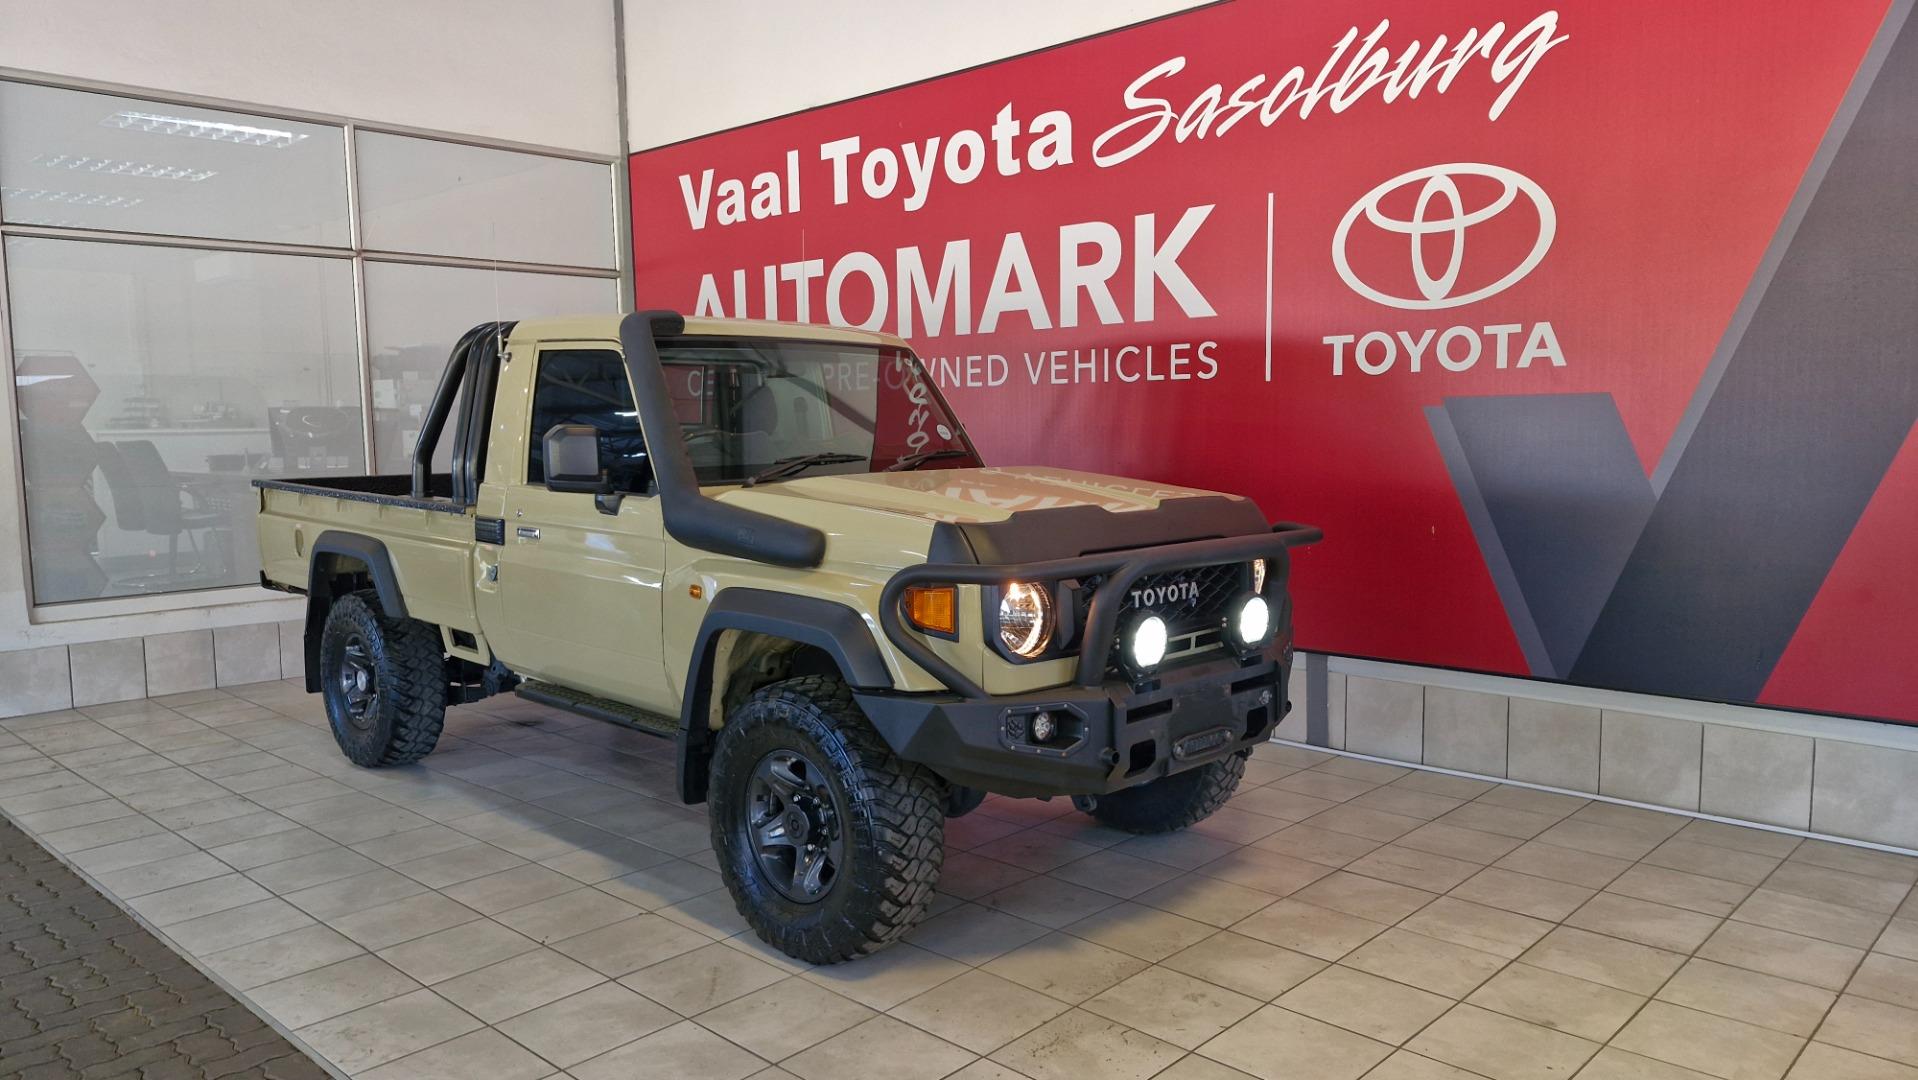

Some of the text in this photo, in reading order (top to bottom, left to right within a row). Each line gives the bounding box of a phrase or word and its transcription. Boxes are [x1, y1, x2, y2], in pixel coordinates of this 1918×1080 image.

[679, 10, 1569, 230] Vaal Toyota Sasolburg
[695, 203, 1218, 338] AUTOMARK
[1024, 341, 1219, 388] VEHICLES
[1323, 321, 1567, 376] TOYOTA
[1131, 581, 1200, 608] TOYOTA
